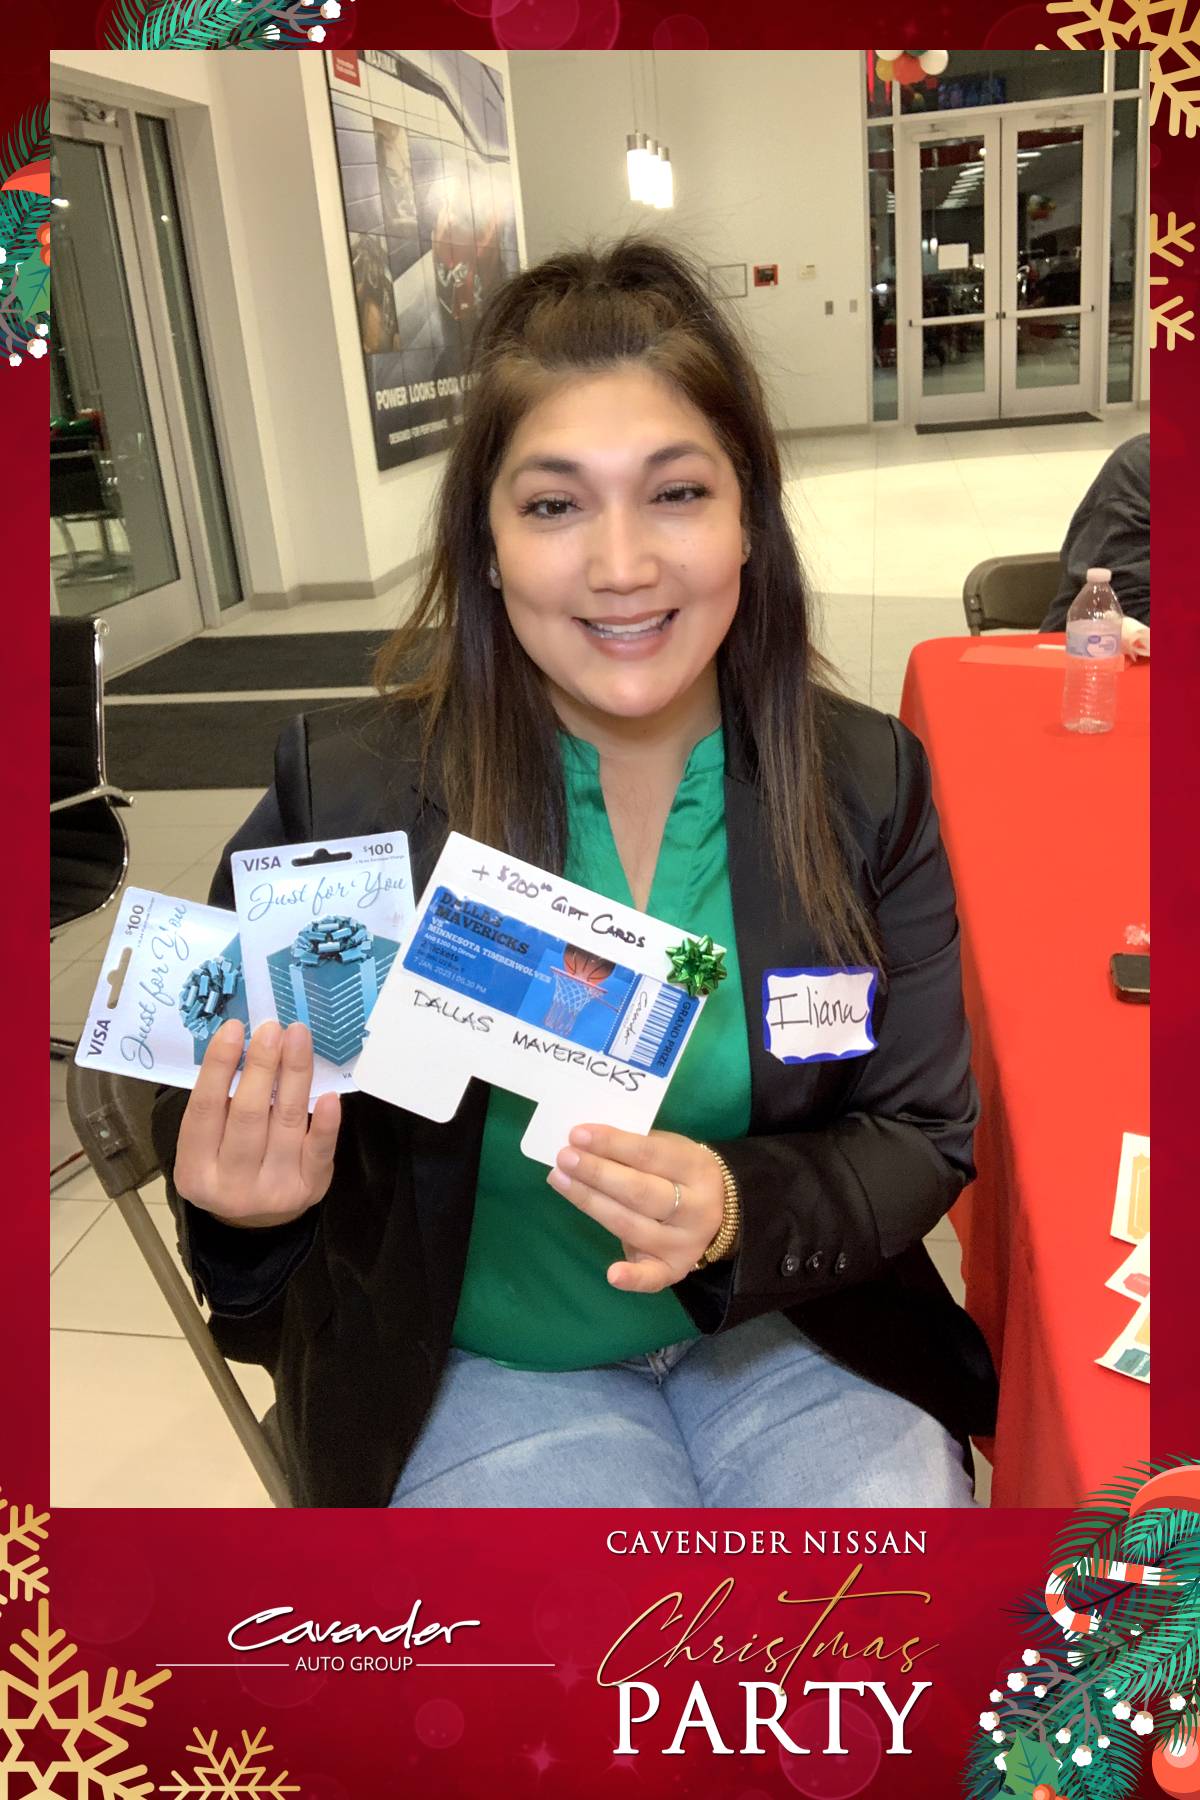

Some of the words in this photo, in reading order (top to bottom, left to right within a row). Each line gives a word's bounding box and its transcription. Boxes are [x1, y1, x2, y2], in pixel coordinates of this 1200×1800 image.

[376, 386, 408, 411] POWER
[409, 381, 436, 403] LOOKS
[437, 376, 459, 397] GOOD
[240, 856, 282, 872] VISA
[363, 843, 393, 856] $100
[247, 883, 306, 922] Just
[312, 876, 349, 916] for
[350, 870, 407, 909] You
[440, 891, 503, 928] DALLAS
[125, 905, 144, 936] $100
[151, 904, 190, 961] You
[430, 916, 444, 928] VS
[434, 904, 530, 955] MAVERICKS
[551, 896, 589, 920] GIFT
[590, 914, 646, 948] CARDS
[420, 939, 427, 947] 2
[427, 942, 460, 962] Tickets
[424, 932, 436, 942] And
[436, 938, 451, 948] $200
[457, 947, 476, 959] Dinner
[427, 923, 481, 952] MINNESOTA
[482, 947, 552, 984] TIMBERWOLVES
[139, 958, 175, 1007] for
[434, 965, 451, 978] 2023
[474, 983, 487, 994] PM
[624, 991, 648, 1045] Cavender
[670, 1001, 691, 1038] GRAND
[766, 986, 868, 1030] Iliana
[86, 1018, 111, 1057] VISA
[120, 1002, 156, 1070] Just
[414, 989, 494, 1033] DALLAS
[512, 1031, 646, 1092] MAVERICKS
[656, 1039, 675, 1067] PRIZE
